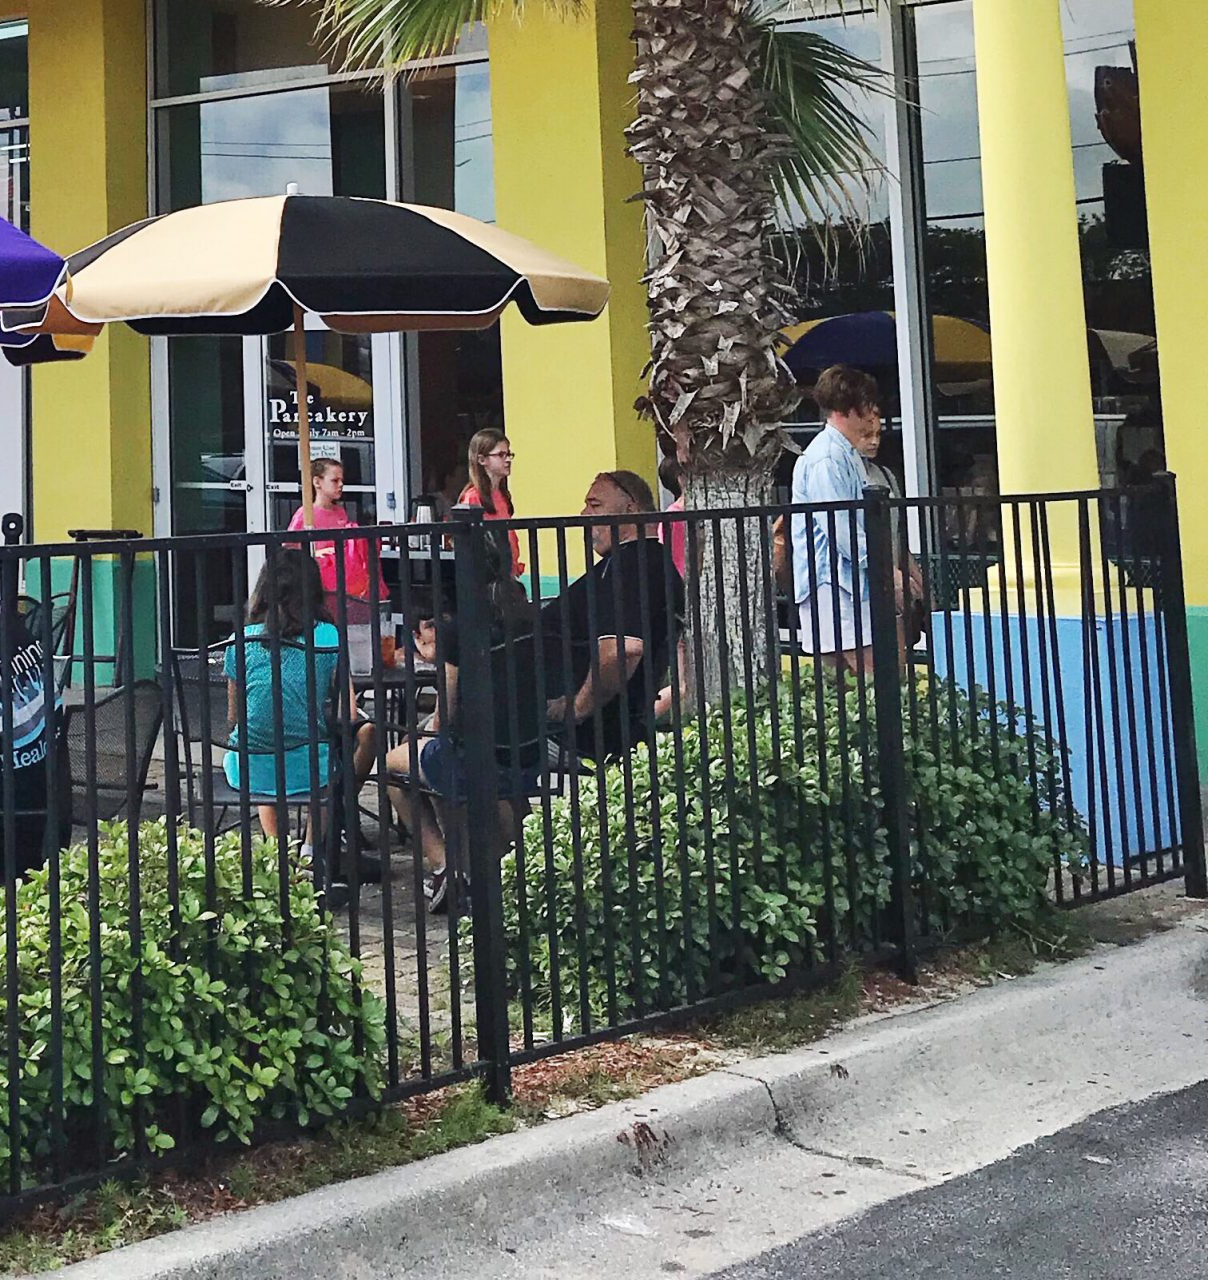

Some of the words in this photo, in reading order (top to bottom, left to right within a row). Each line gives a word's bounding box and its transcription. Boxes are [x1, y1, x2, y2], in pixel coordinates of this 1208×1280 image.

[289, 390, 315, 405] Te
[272, 428, 296, 439] Open
[322, 428, 339, 438] 7am
[346, 428, 365, 439] 2pm
